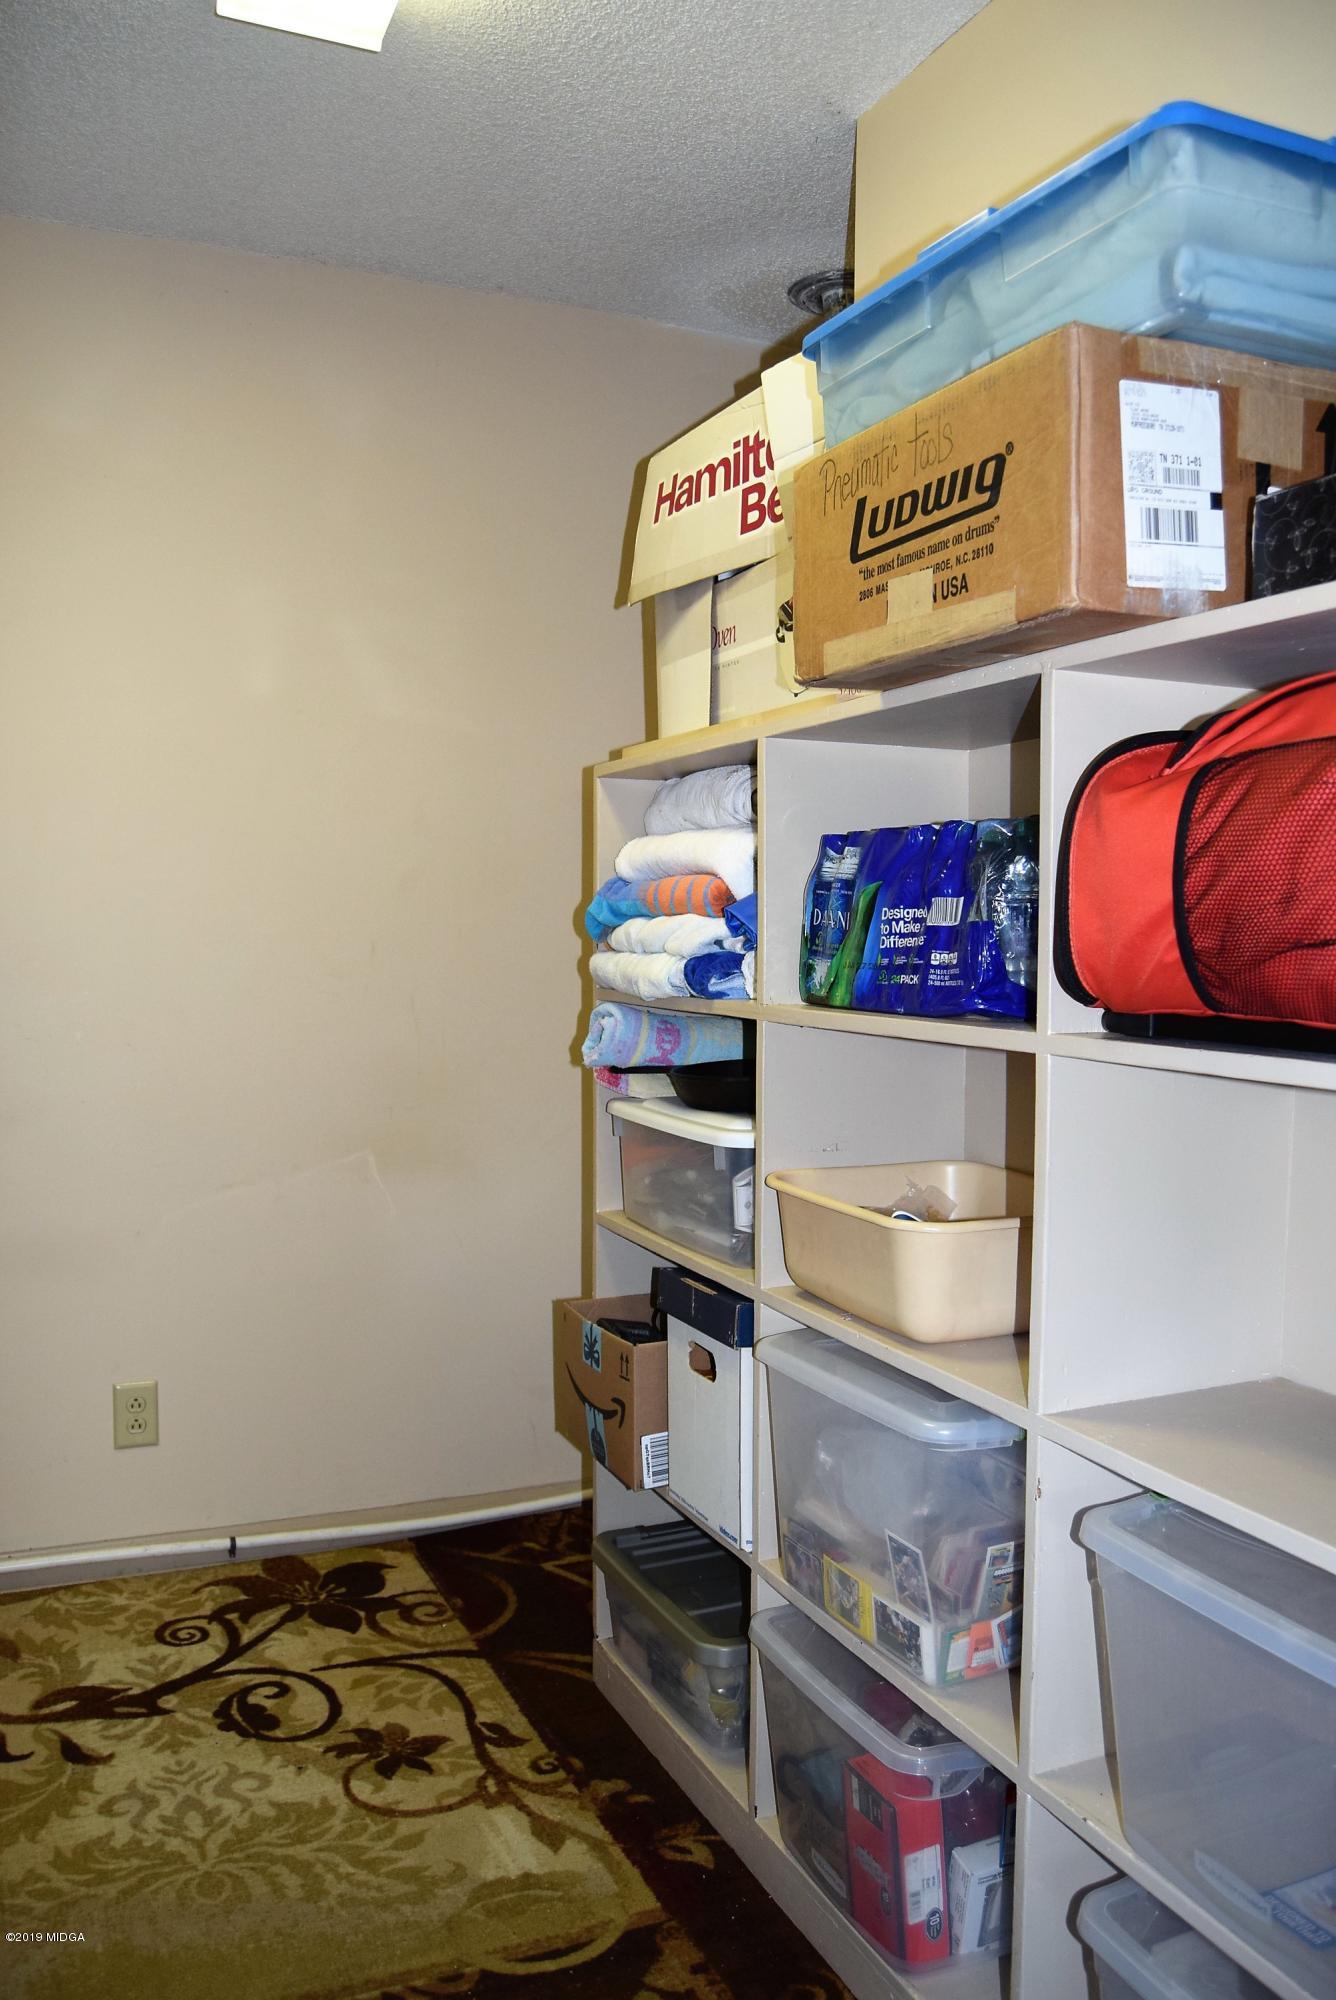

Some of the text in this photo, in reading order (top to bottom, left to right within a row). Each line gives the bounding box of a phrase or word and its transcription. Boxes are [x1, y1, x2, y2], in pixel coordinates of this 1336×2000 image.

[1160, 453, 1168, 464] TN
[820, 437, 899, 516] Pneumatic
[877, 559, 895, 576] most
[896, 545, 926, 568] famous
[927, 539, 951, 557] name
[952, 534, 964, 546] on
[941, 572, 969, 600] USA
[880, 923, 889, 935] to
[891, 920, 921, 934] Make
[880, 935, 925, 949] Differene
